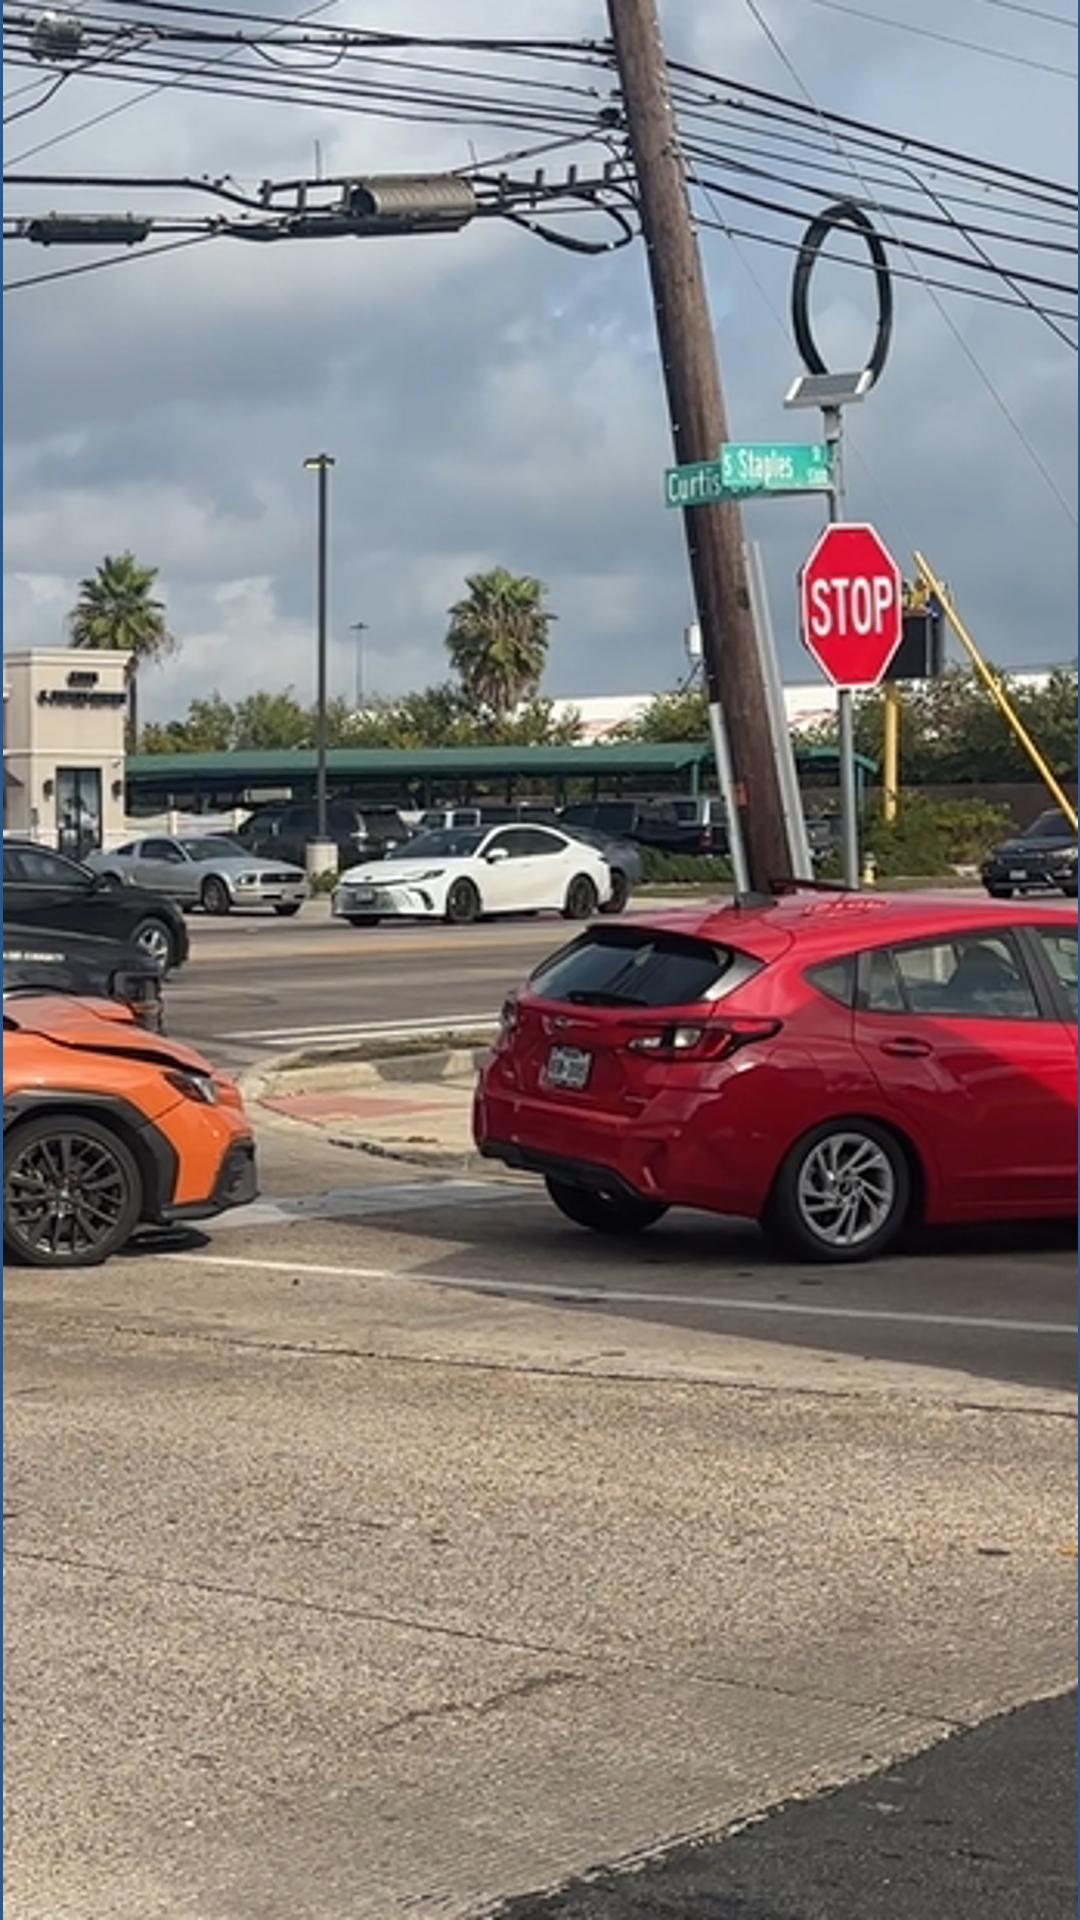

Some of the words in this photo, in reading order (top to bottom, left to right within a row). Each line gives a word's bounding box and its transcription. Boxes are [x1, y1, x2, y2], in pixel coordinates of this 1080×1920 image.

[723, 453, 733, 477] S
[737, 448, 794, 484] Staples
[668, 468, 723, 502] Curtis
[811, 576, 893, 636] STOP
